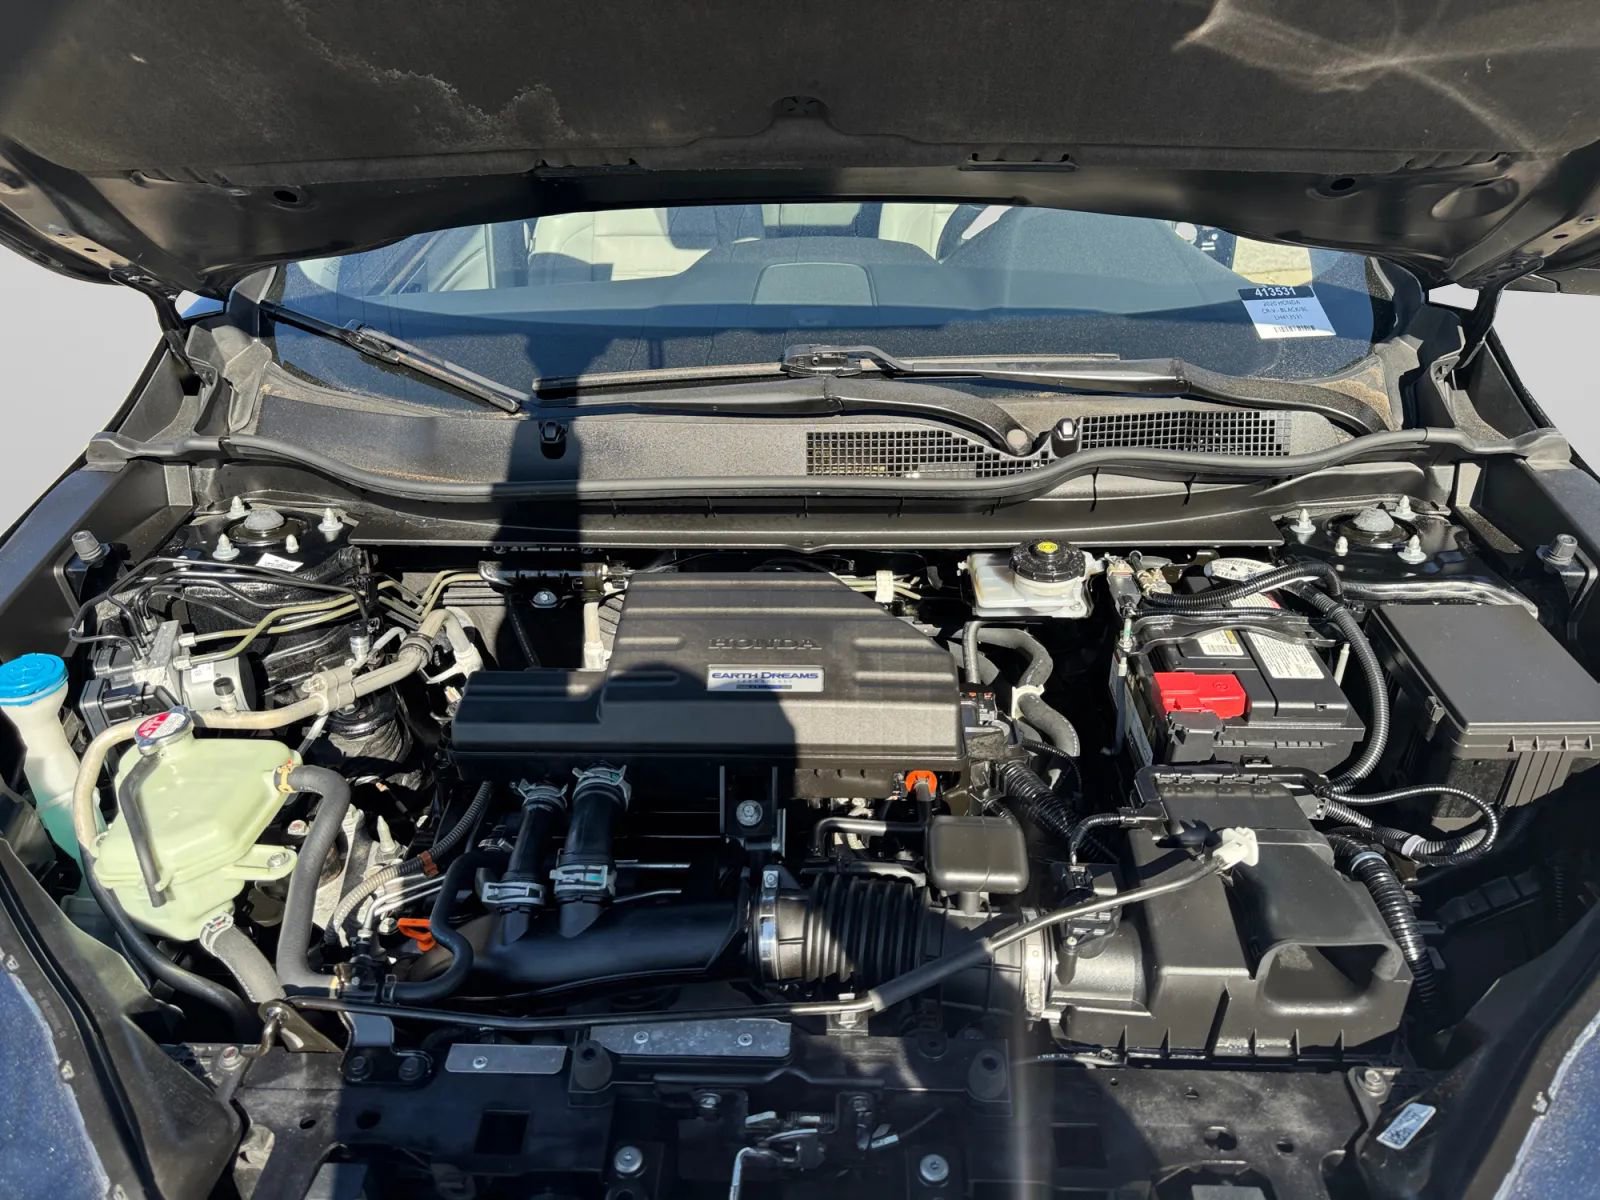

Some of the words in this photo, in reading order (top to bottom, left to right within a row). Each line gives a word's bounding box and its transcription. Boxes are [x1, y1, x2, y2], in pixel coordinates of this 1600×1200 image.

[1255, 286, 1296, 297] 413531
[707, 638, 823, 651] HONDA
[711, 672, 758, 680] EARTH
[760, 671, 820, 680] DREAMS
